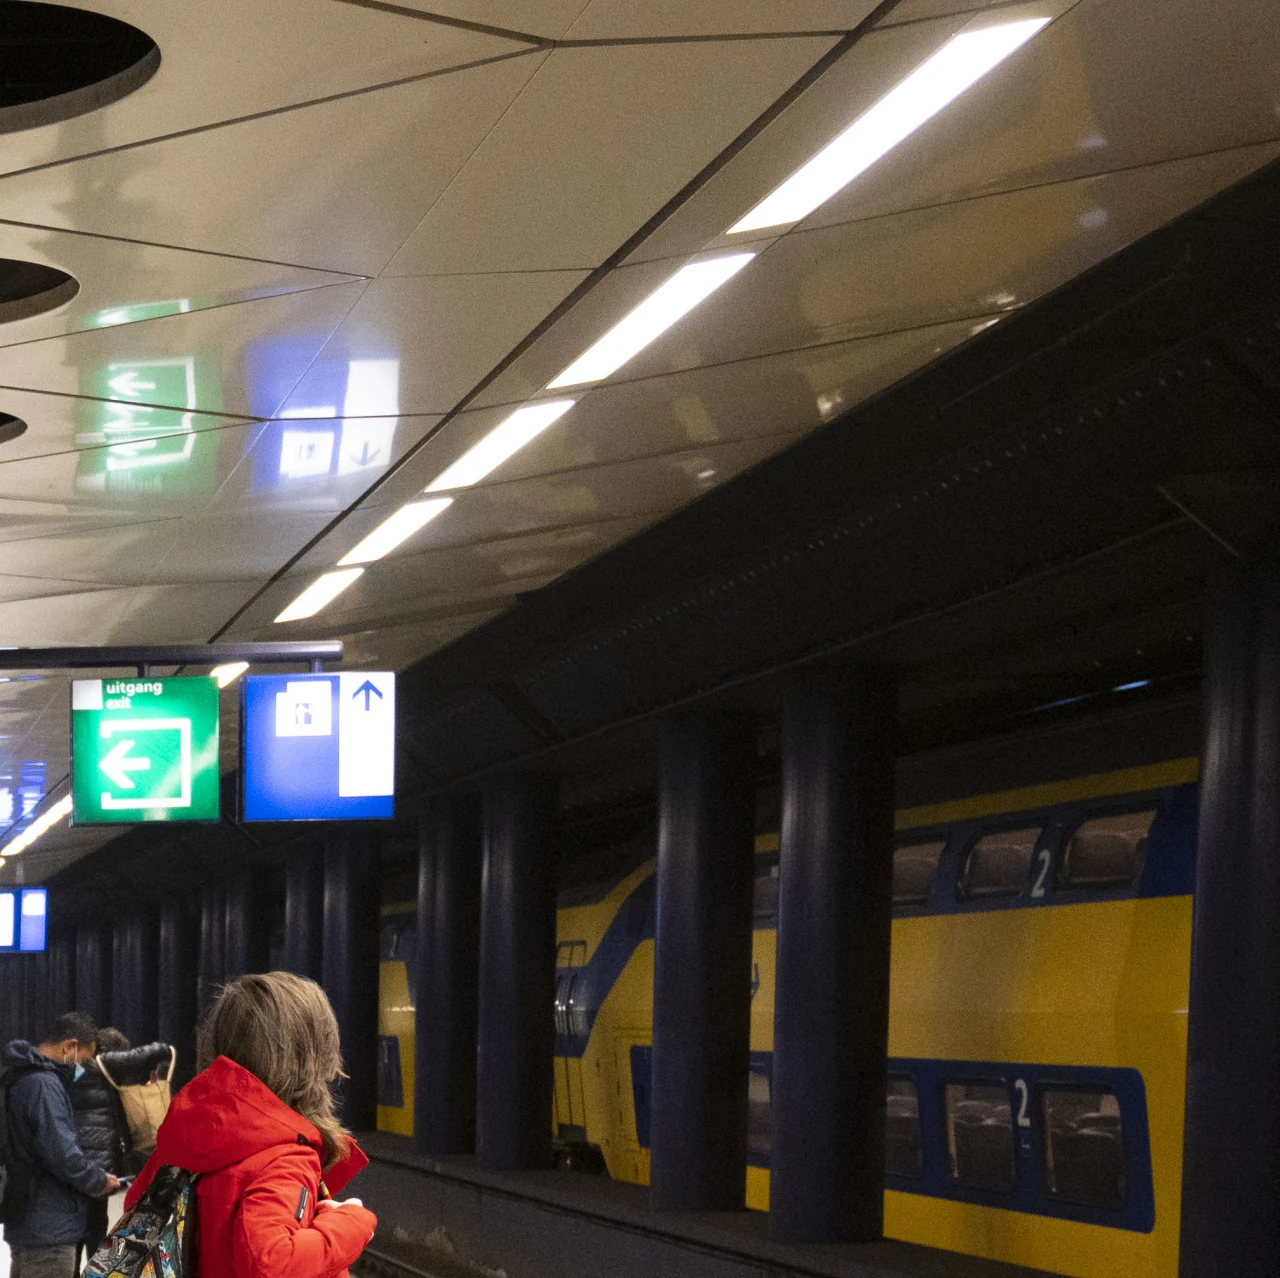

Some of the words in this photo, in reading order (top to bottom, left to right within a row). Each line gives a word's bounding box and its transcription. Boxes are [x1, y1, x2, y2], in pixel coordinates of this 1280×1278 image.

[105, 696, 132, 710] exit
[106, 681, 163, 697] uitgang
[1031, 848, 1051, 898] 2
[1015, 1078, 1031, 1128] 2
